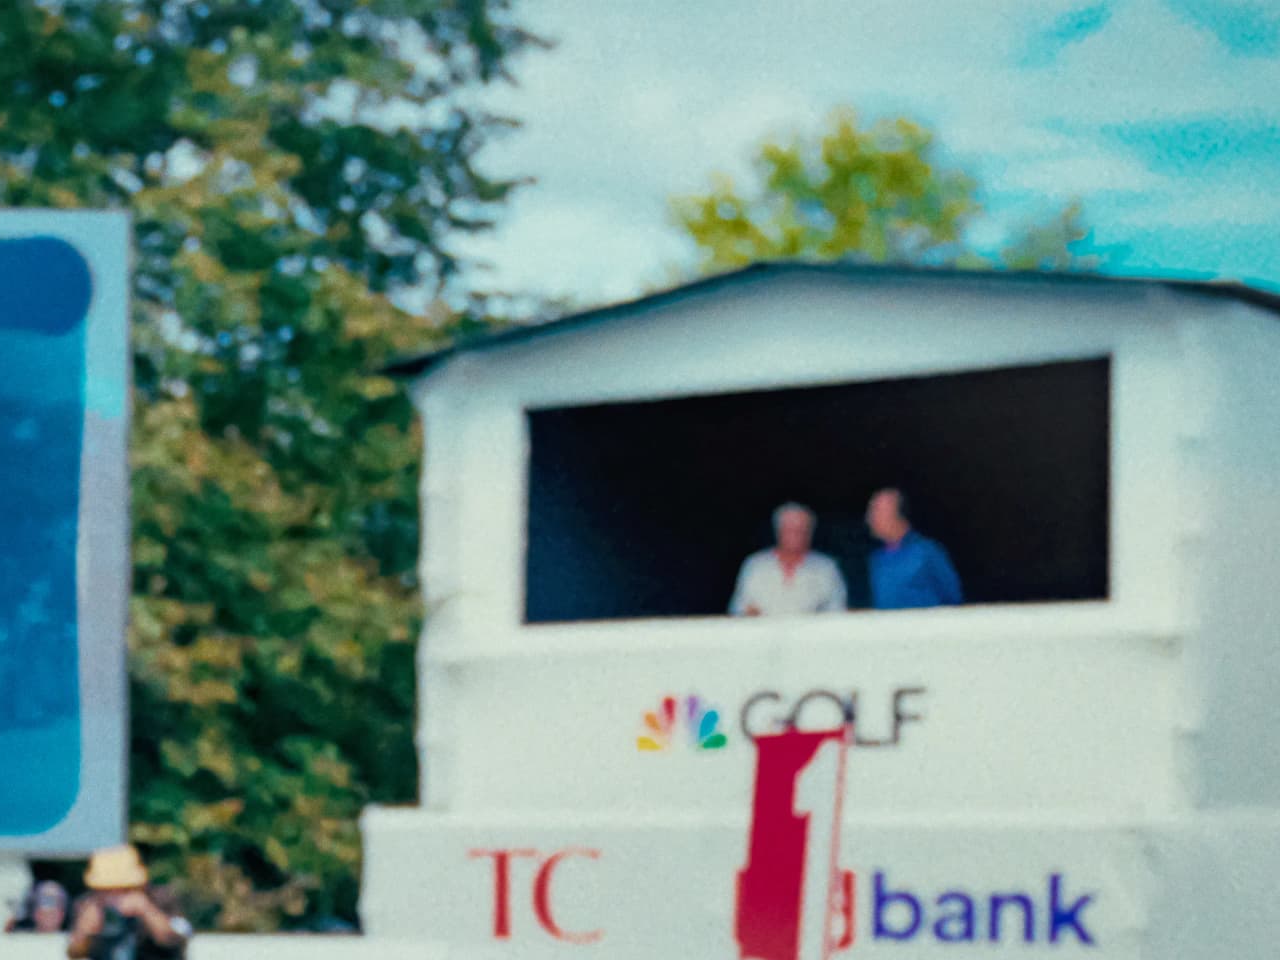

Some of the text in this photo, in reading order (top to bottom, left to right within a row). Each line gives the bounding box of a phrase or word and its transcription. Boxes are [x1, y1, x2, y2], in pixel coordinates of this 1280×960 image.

[741, 687, 927, 748] GOLF
[467, 846, 603, 943] TC
[872, 871, 1095, 945] bank
